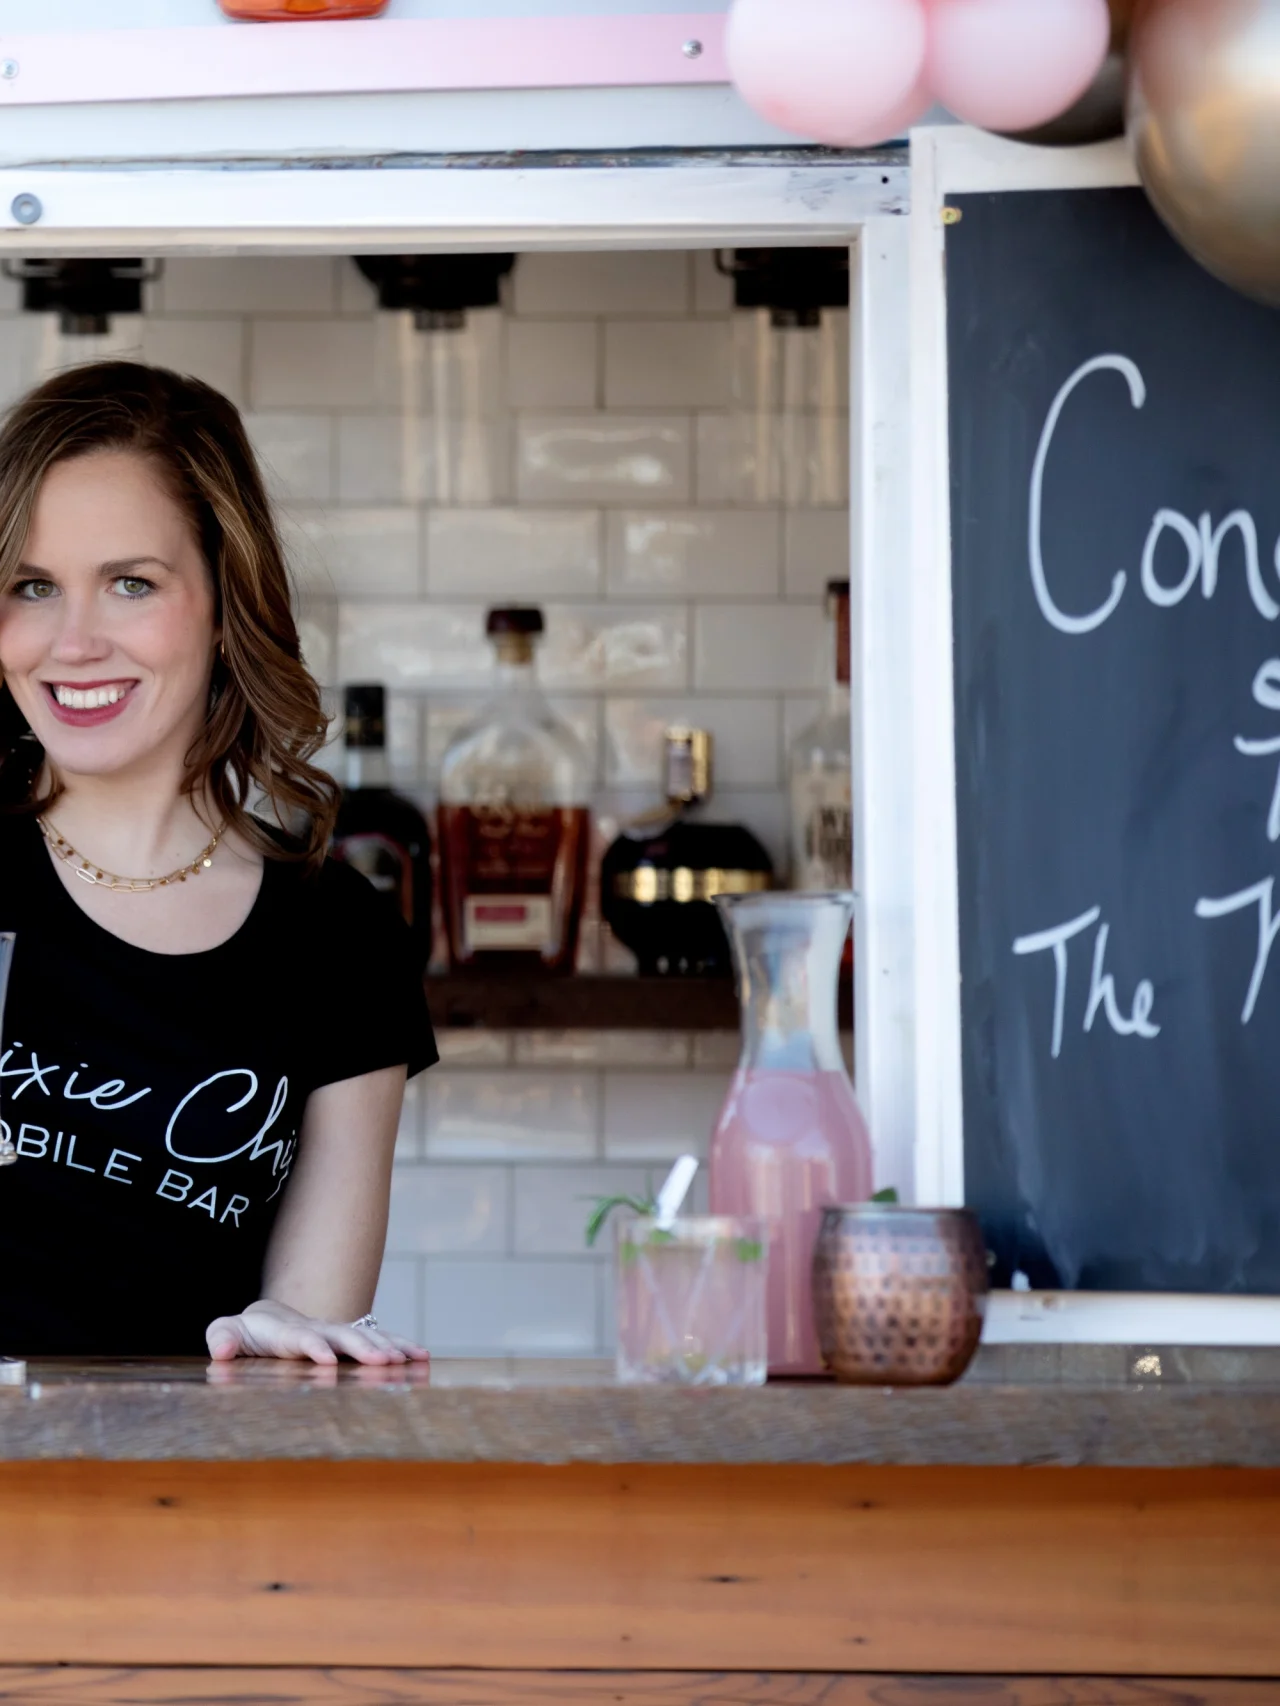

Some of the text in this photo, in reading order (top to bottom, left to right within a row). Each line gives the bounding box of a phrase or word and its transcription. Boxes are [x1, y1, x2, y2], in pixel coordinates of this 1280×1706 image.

[1028, 353, 1280, 634] Con
[1013, 904, 1161, 1058] The
[156, 1168, 250, 1228] BAR
